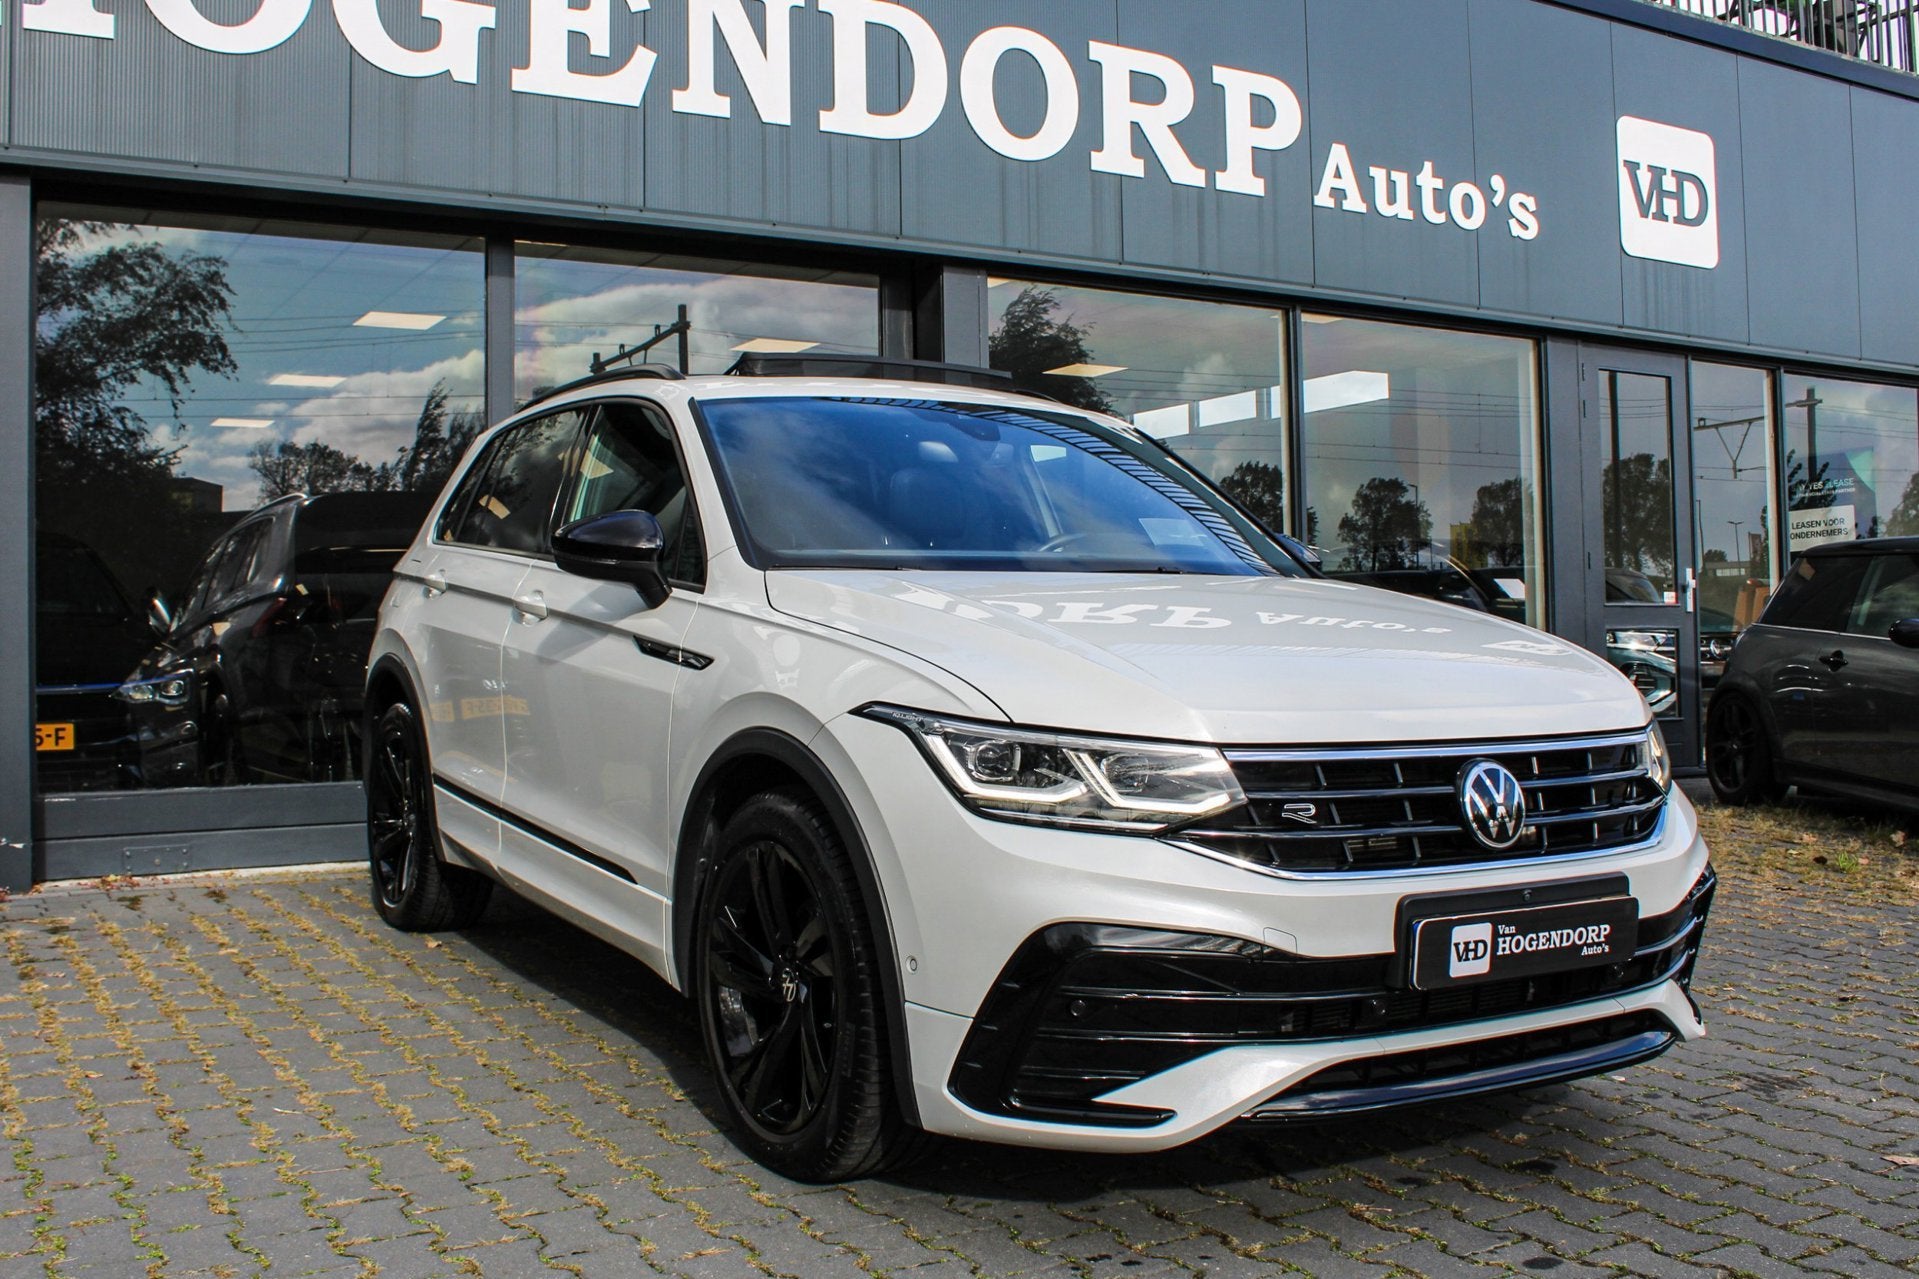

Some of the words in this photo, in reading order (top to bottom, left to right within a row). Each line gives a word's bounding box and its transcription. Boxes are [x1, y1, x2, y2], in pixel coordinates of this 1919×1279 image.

[1313, 141, 1539, 241] Auto's
[1622, 158, 1710, 228] VHD
[1791, 520, 1821, 530] LEASEN
[1822, 517, 1845, 527] VOOR
[1790, 527, 1848, 540] ONDERNEMERS
[1498, 924, 1516, 935] Van
[1496, 924, 1612, 956] HOGENDORP
[1581, 942, 1610, 956] Auto's
[1453, 938, 1489, 963] VHD
